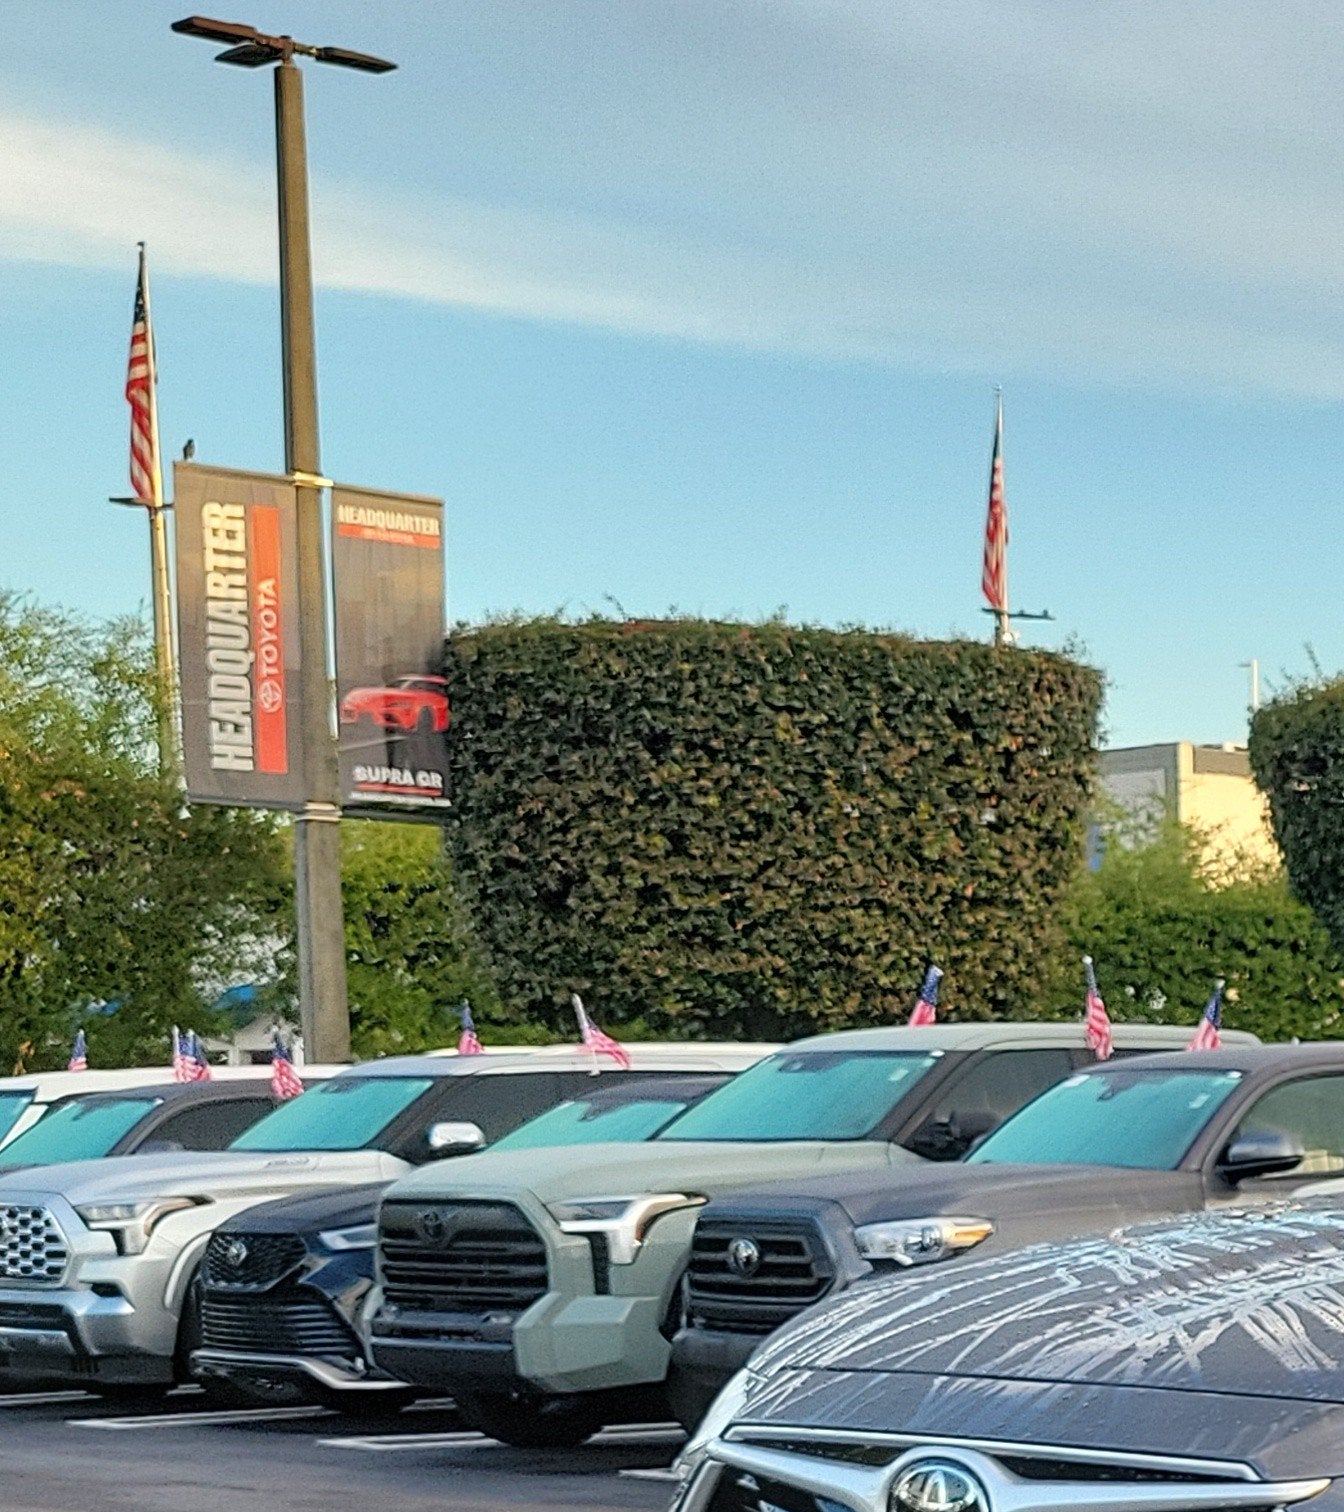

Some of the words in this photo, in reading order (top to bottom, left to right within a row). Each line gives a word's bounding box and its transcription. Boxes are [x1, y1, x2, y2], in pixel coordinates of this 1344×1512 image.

[338, 504, 440, 536] HEADQUARTER
[201, 501, 255, 772] HEADQUARTER
[257, 577, 280, 677] TOYOTA
[353, 765, 415, 787] SUPRA
